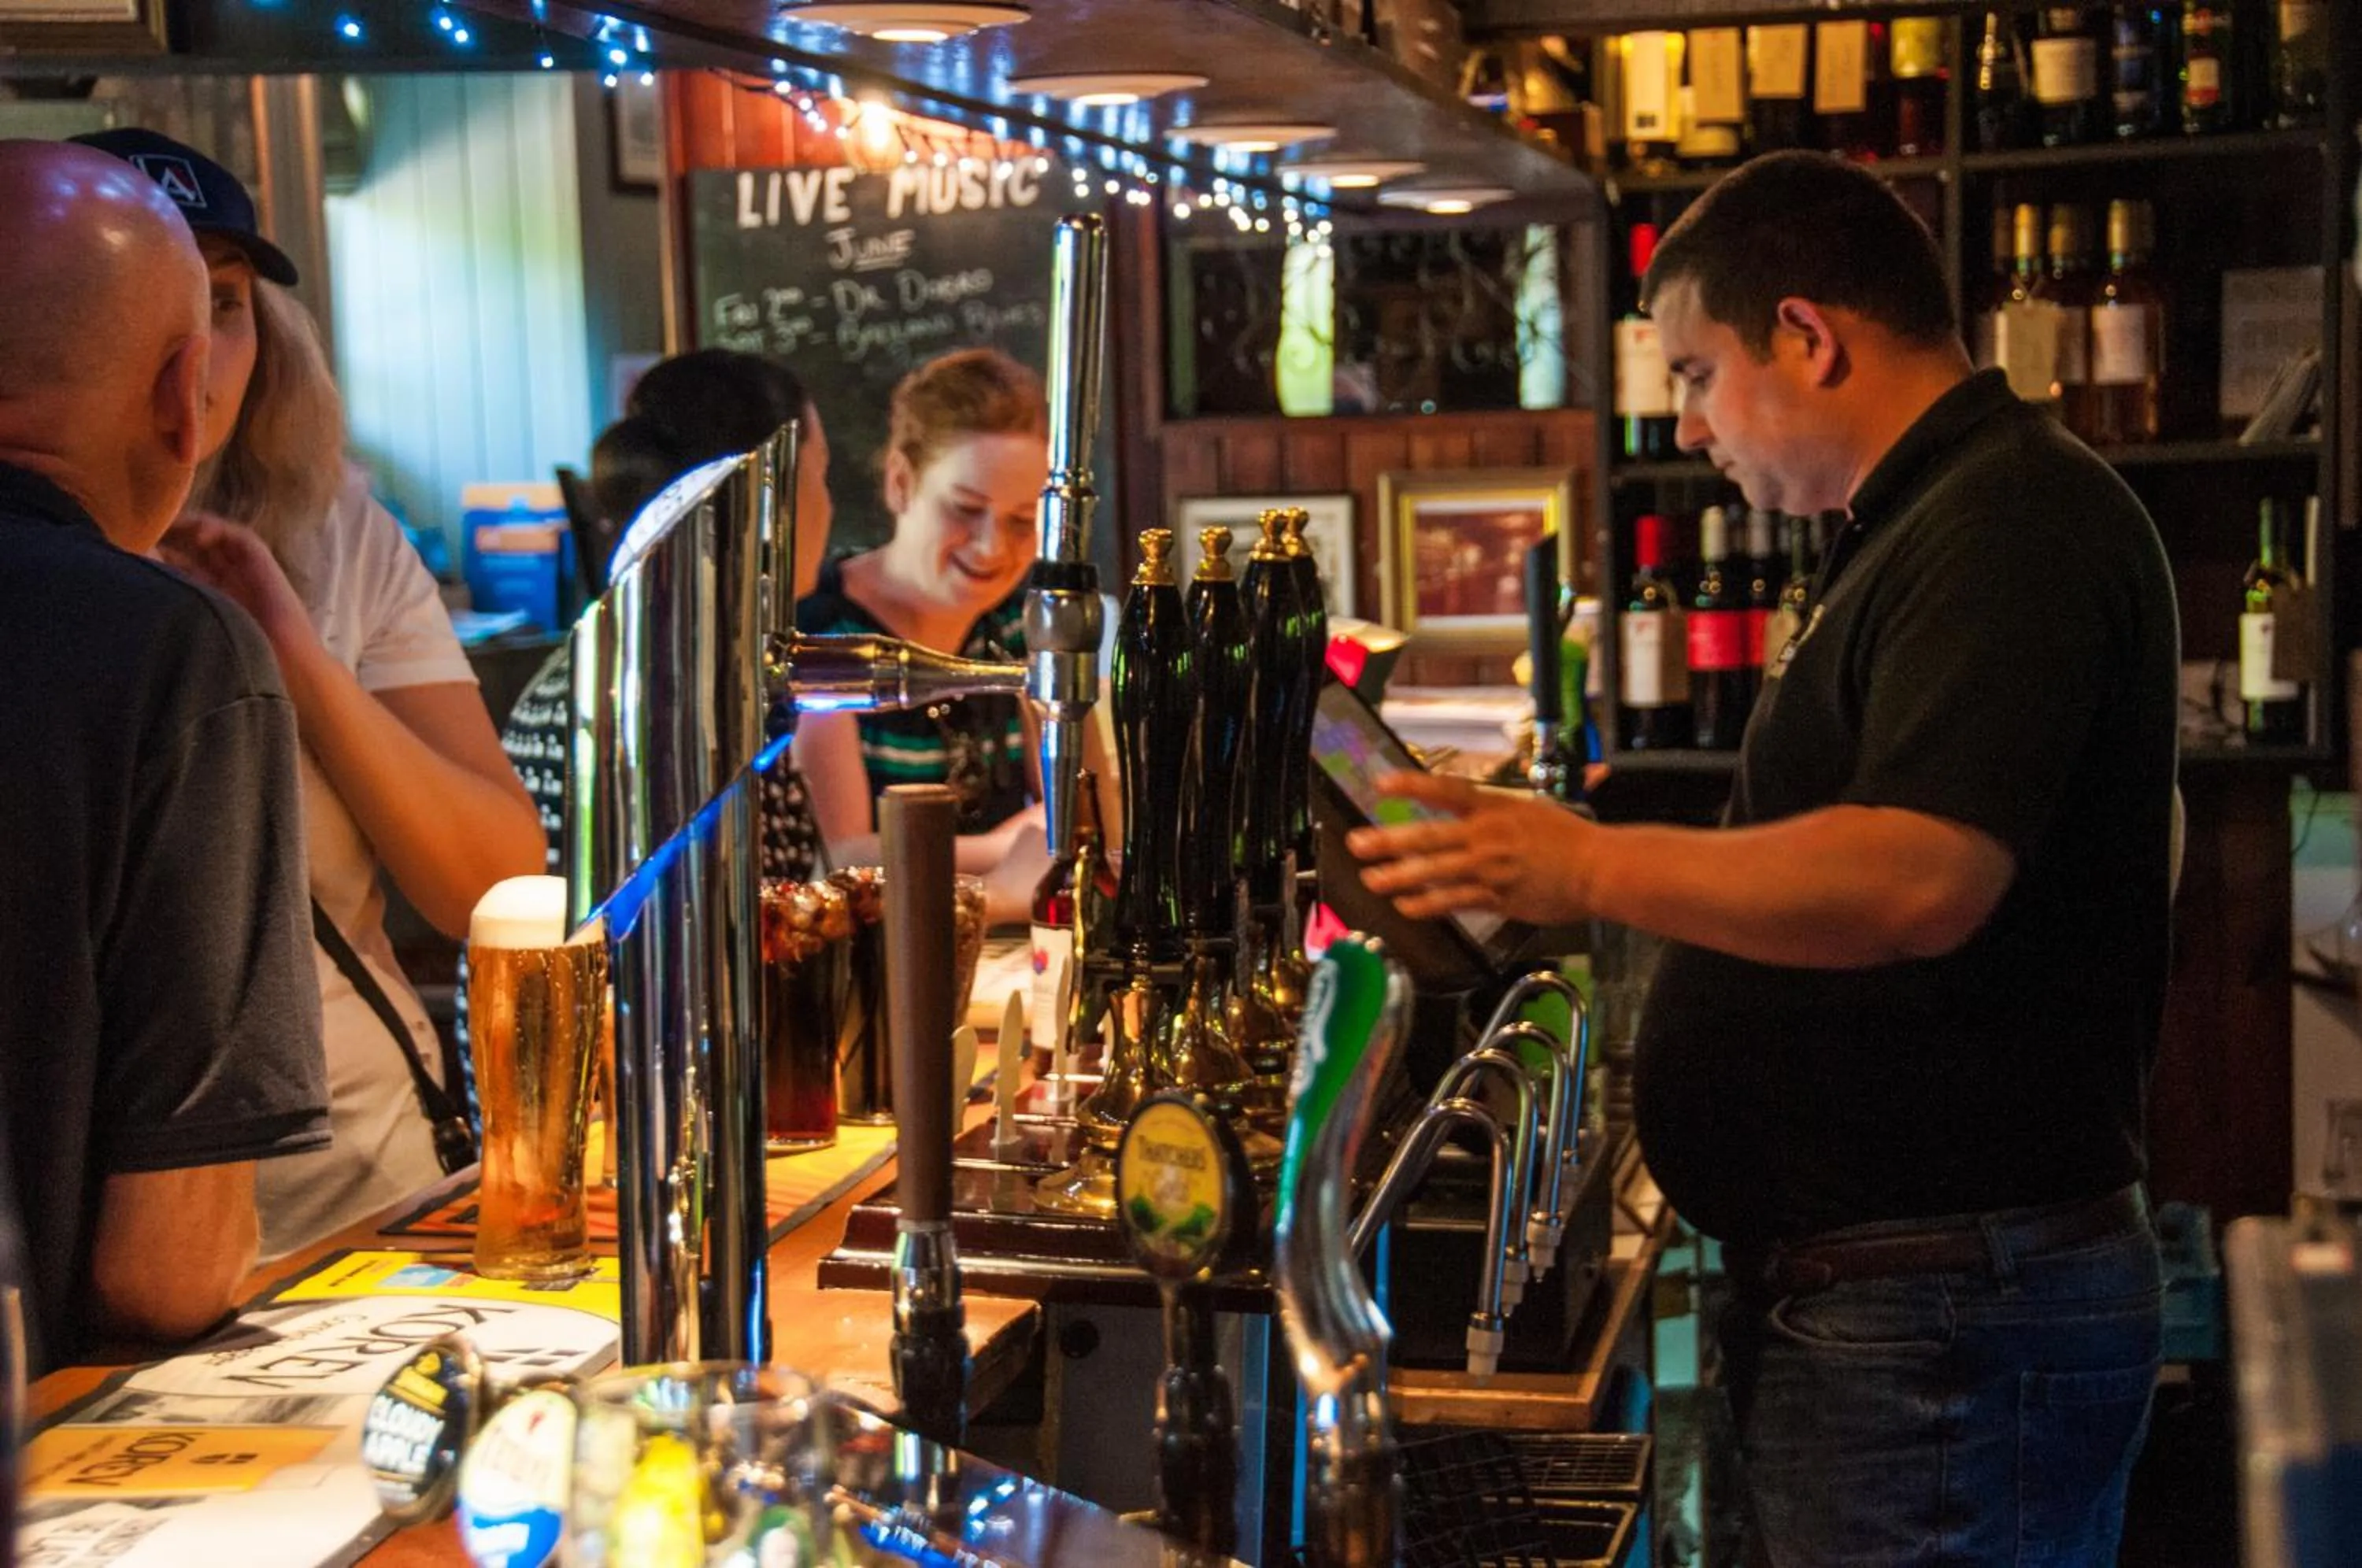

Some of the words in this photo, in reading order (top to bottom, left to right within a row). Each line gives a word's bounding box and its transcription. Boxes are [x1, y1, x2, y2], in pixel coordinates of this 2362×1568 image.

[737, 167, 855, 229] LIVE
[887, 157, 1040, 219] MUSIC
[224, 1304, 517, 1388] KOREV
